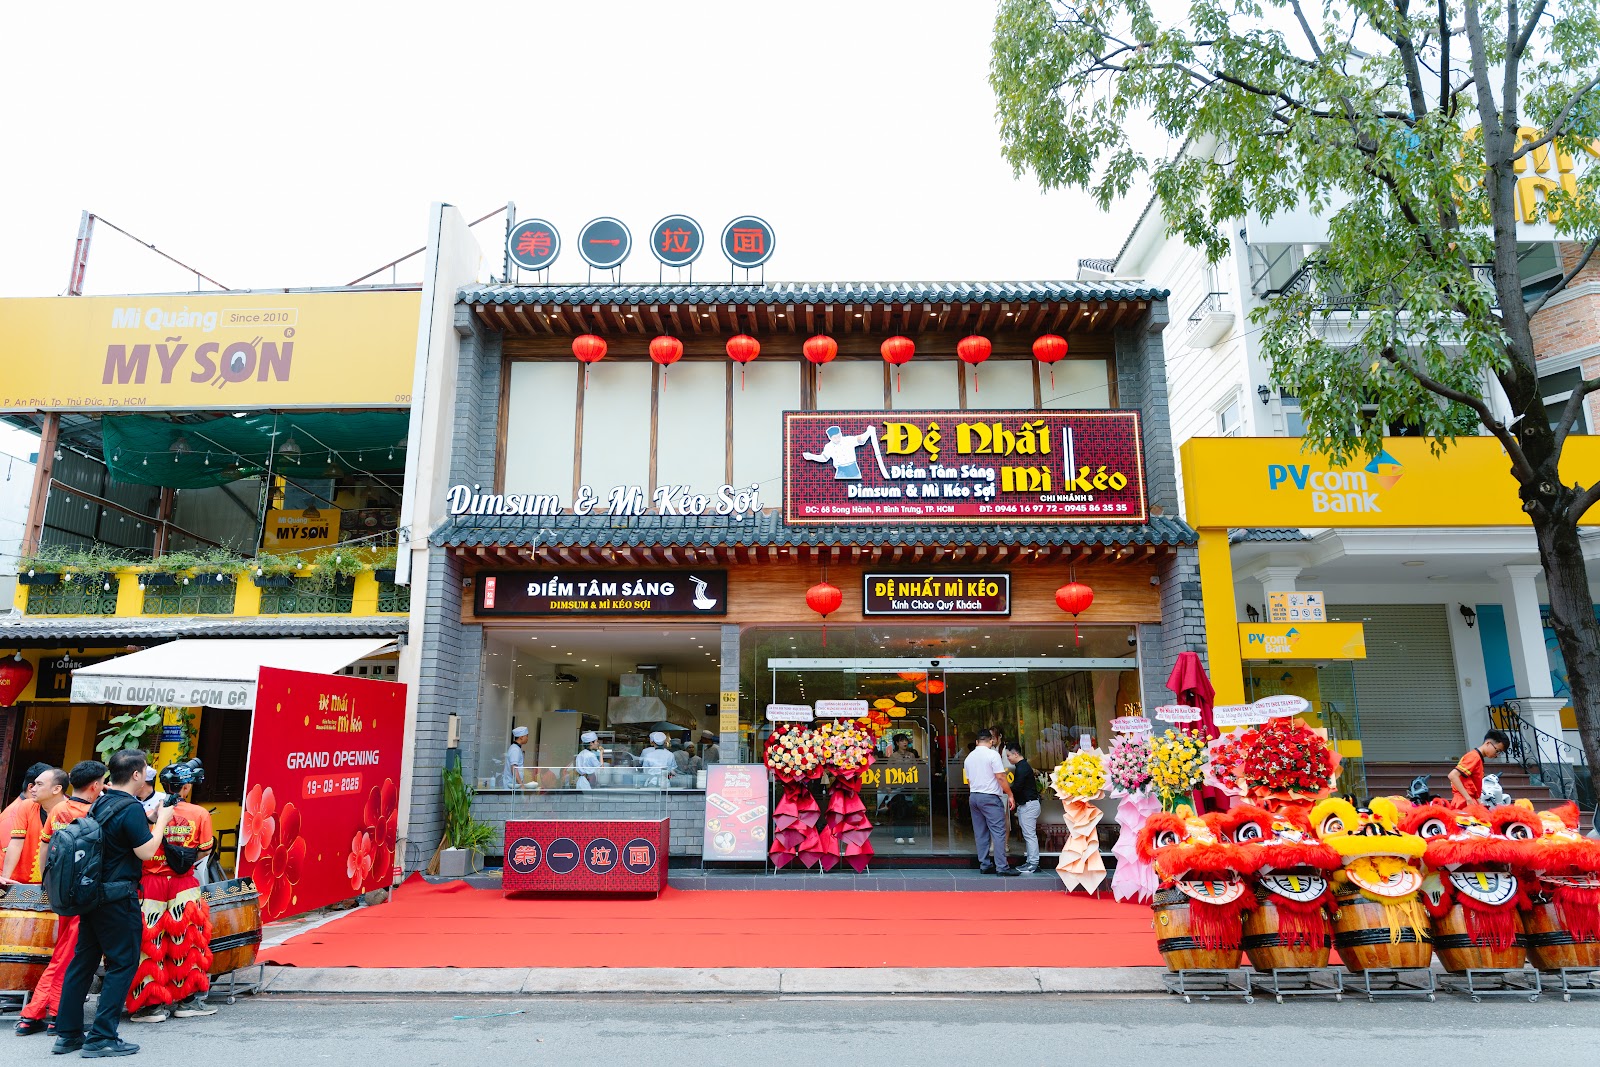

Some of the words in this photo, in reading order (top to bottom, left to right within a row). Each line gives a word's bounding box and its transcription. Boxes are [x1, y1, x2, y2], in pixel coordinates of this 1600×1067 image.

[144, 306, 218, 333] Quảng
[230, 313, 260, 323] Since
[263, 312, 289, 322] 2010
[102, 336, 189, 385] MỸ
[14, 398, 27, 407] An
[51, 398, 64, 408] Tp.
[66, 397, 82, 406] Thủ
[108, 397, 121, 408] Tp.
[123, 397, 147, 406] HCM
[394, 394, 412, 403] 090
[880, 420, 942, 462] Đệ
[955, 419, 1051, 457] Nhất
[890, 461, 927, 479] Điểm
[929, 463, 958, 479] Tâm
[960, 463, 996, 482] Sáng
[1000, 465, 1052, 492] Mì
[1268, 464, 1368, 491] PVcom
[446, 484, 563, 516] Dimsum
[573, 485, 599, 516] &
[653, 485, 711, 516] Kéo
[715, 482, 764, 522] Sợi
[847, 483, 902, 498] Dimsum
[905, 484, 918, 498] &
[921, 483, 940, 498] Mì
[943, 483, 970, 498] Kéo
[973, 482, 996, 502] Sợi
[1039, 494, 1056, 502] CHI
[1057, 492, 1087, 502] NHÁNH
[1312, 492, 1382, 512] Bank
[804, 505, 820, 514] ĐC:
[821, 505, 830, 513] 68
[831, 505, 851, 515] Song
[852, 505, 874, 515] Hành,
[875, 505, 882, 513] P.
[883, 505, 899, 513] Bình
[901, 505, 924, 515] Trưng,
[925, 505, 935, 513] TP.
[936, 505, 955, 513] HCM
[979, 504, 994, 513] ĐT:
[994, 504, 1018, 513] 0946
[1019, 504, 1031, 513] 16
[1032, 504, 1045, 513] 97
[1046, 504, 1058, 512] 72
[1064, 504, 1087, 512] 0945
[1088, 504, 1101, 512] 86
[1102, 504, 1114, 512] 35
[1115, 503, 1128, 512] 35
[276, 525, 300, 540] MỸ
[527, 575, 574, 597] ĐIỂM
[578, 579, 617, 597] TÂM
[621, 578, 675, 597] SÁNG
[874, 578, 895, 601] ĐỆ
[898, 576, 941, 597] NHẤT
[944, 578, 963, 597] MÌ
[967, 578, 999, 597] KÉO
[550, 600, 589, 609] DIMSUM
[590, 601, 597, 609] &
[599, 599, 610, 609] MÌ
[612, 599, 632, 609] KÉO
[634, 600, 651, 611] SỢI
[891, 600, 909, 610] Kính
[911, 600, 935, 610] Chào
[936, 600, 955, 611] Quý
[956, 600, 982, 610] Khách
[1248, 633, 1287, 645] PVcom
[1265, 644, 1292, 653] Bank
[103, 681, 123, 701] MÌ
[126, 681, 176, 703] QUẢNG
[190, 688, 223, 705] CƠM
[227, 685, 248, 706] GÀ
[318, 693, 330, 714] Đệ
[287, 751, 330, 770] GRAND
[333, 749, 380, 767] OPENING
[860, 768, 881, 788] Đệ
[885, 765, 919, 785] Nhất
